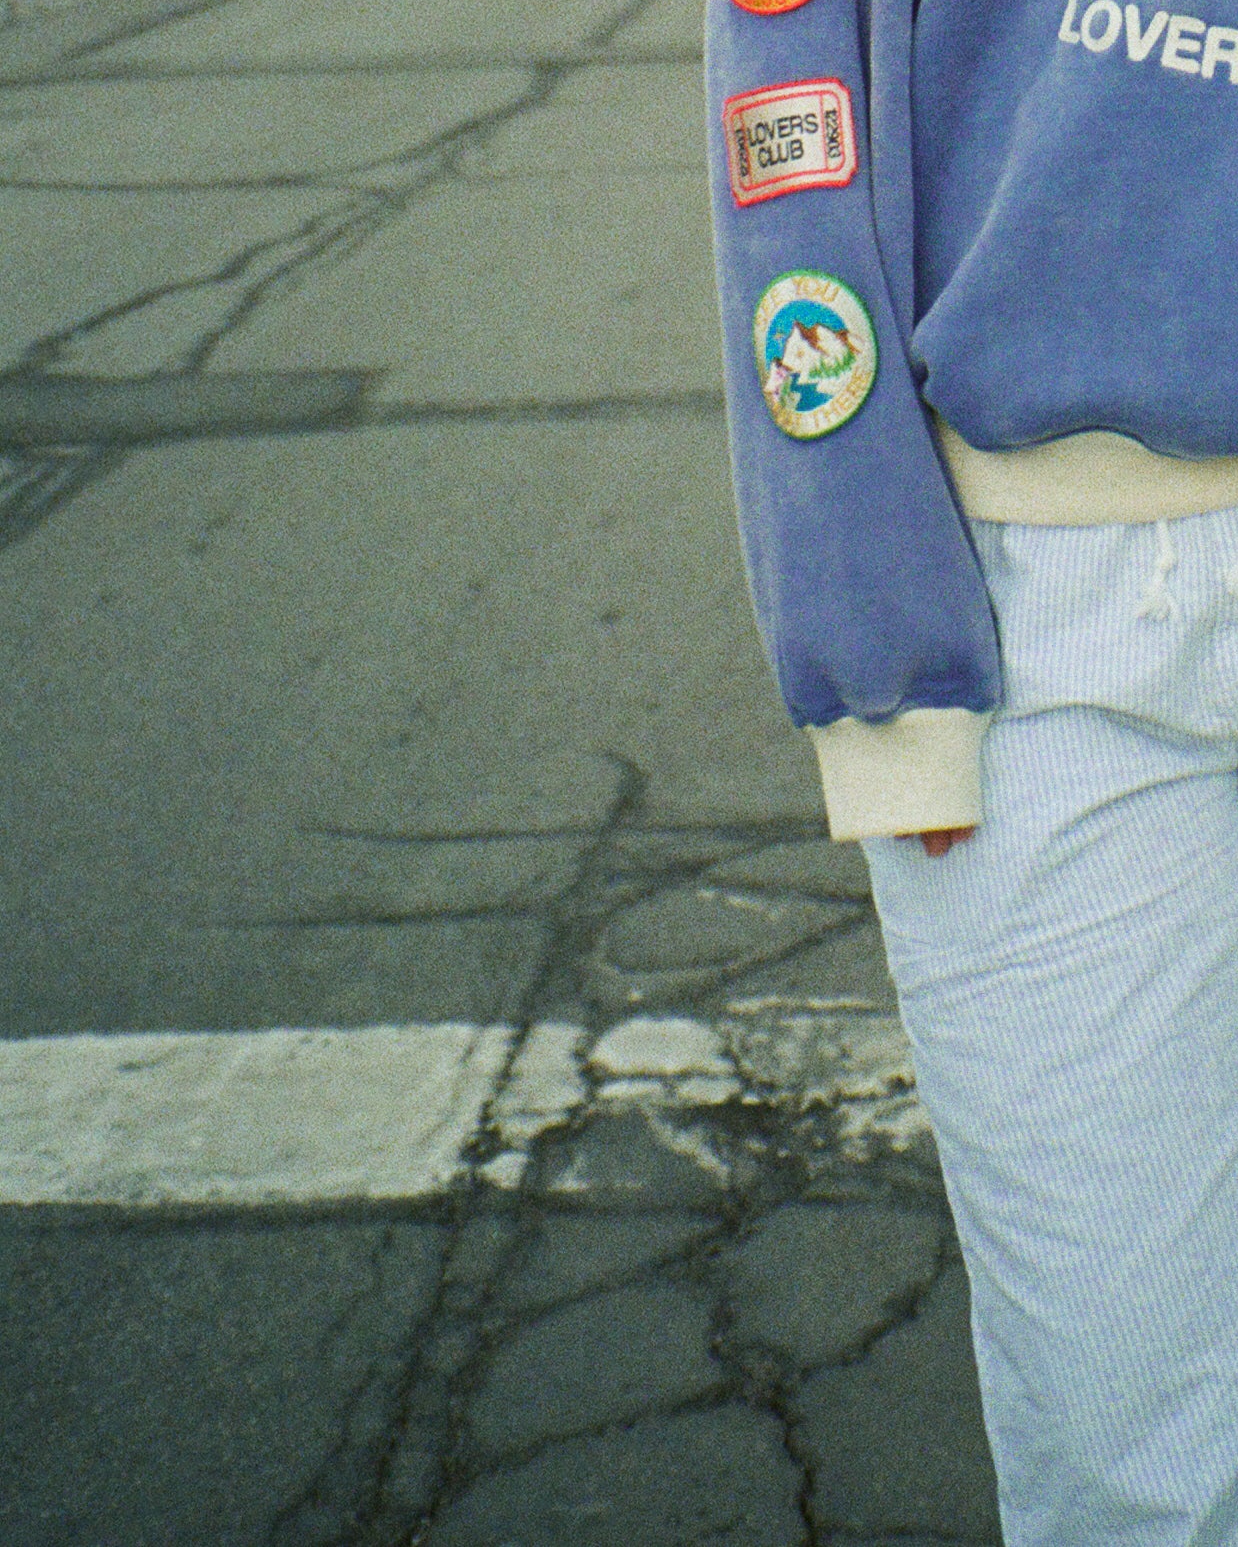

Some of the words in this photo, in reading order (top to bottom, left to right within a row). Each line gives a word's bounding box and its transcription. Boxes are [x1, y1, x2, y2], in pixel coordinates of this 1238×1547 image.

[747, 113, 819, 147] LOVERS
[758, 138, 804, 168] CLUB
[792, 276, 839, 302] YOU
